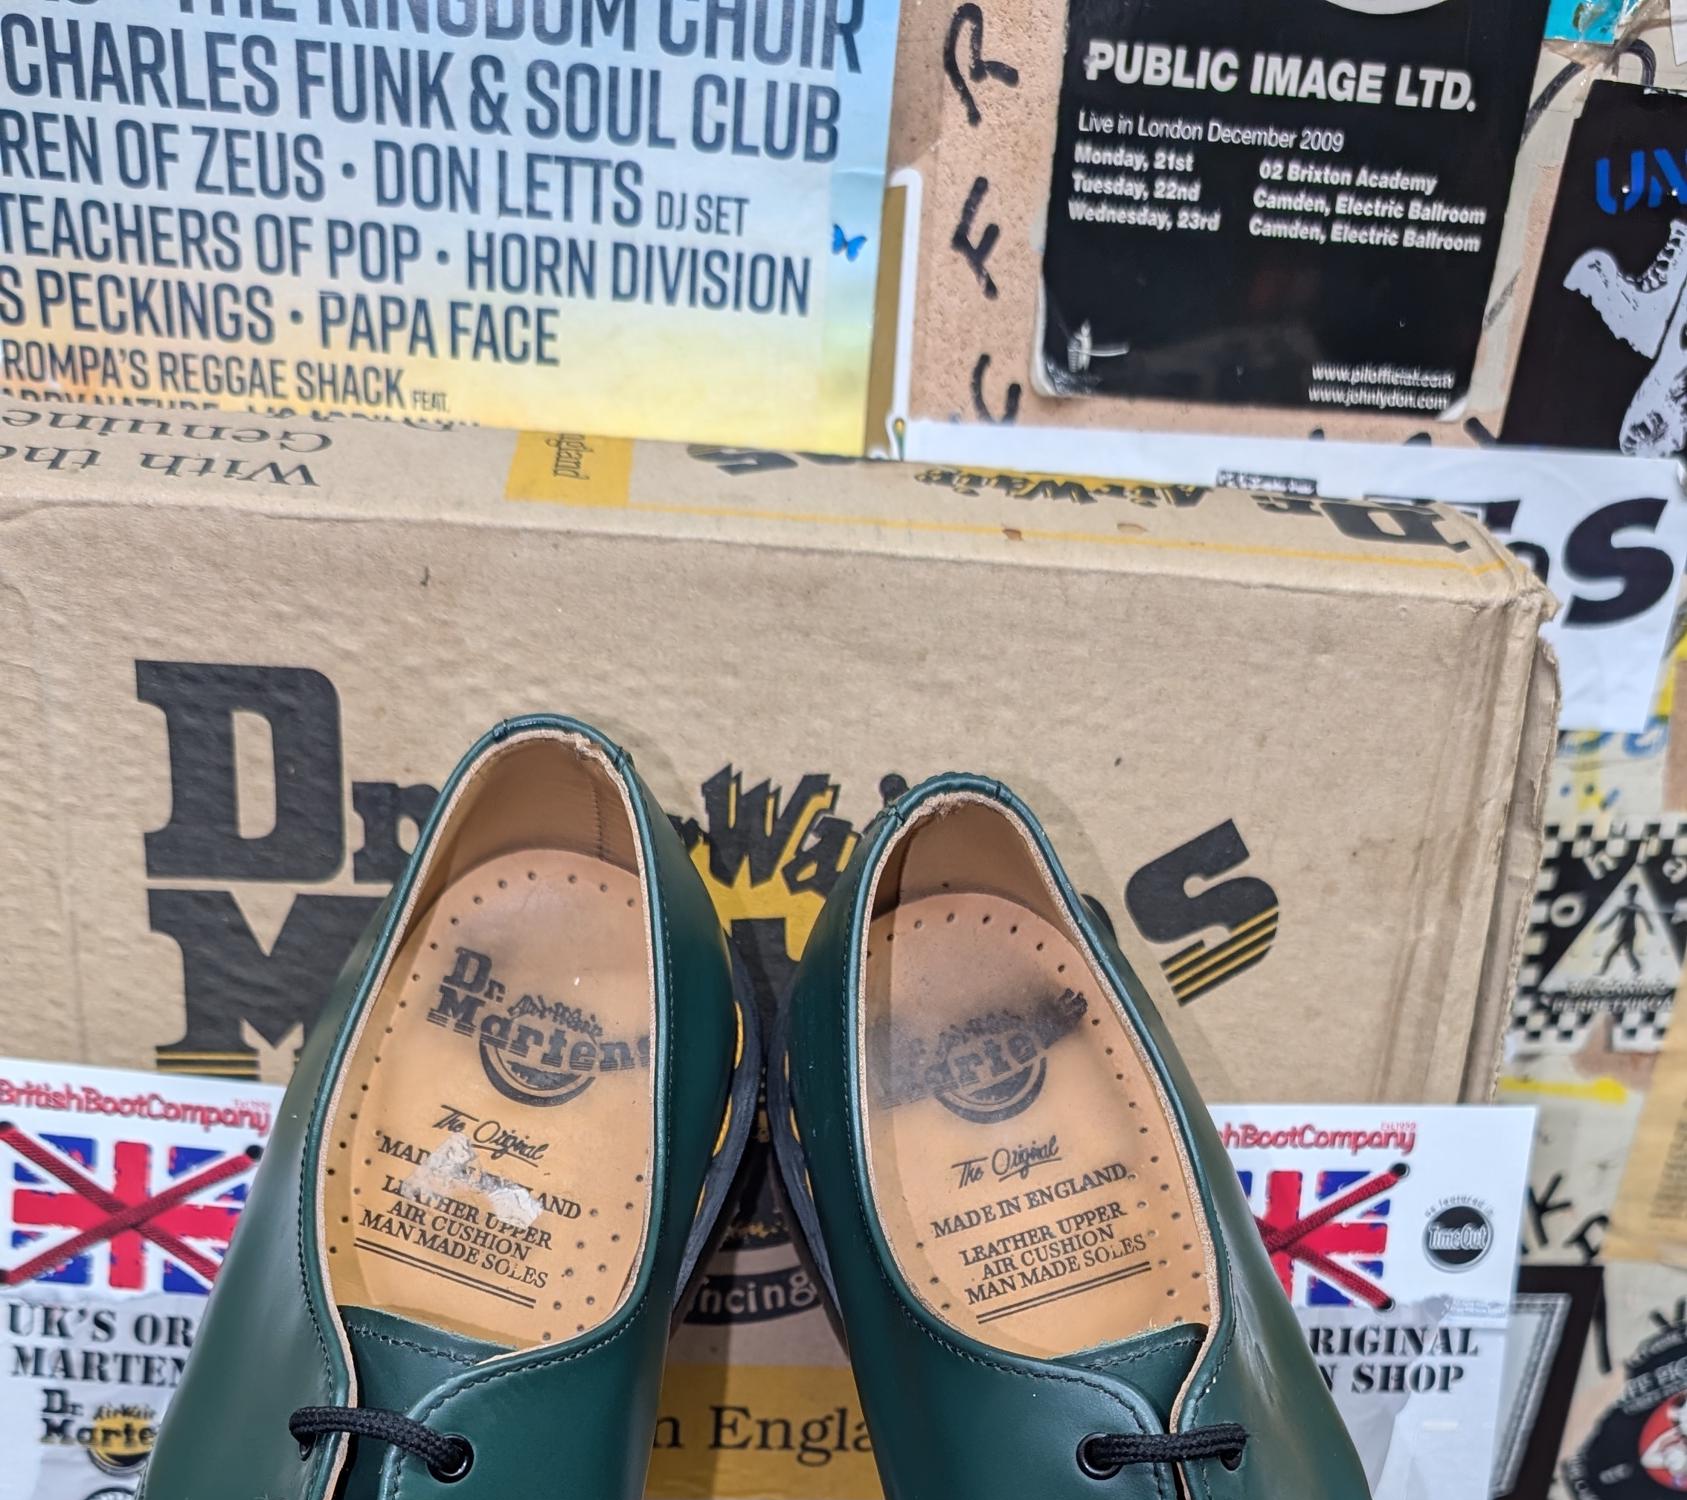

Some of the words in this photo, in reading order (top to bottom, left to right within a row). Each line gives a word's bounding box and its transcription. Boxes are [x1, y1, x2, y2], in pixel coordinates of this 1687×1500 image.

[2, 13, 280, 117] CHARLES
[296, 39, 457, 131] FUNK
[470, 54, 512, 136] &
[526, 60, 676, 149] SOUL
[693, 74, 842, 163] CLUB
[1084, 40, 1240, 92] PUBLIC
[1250, 52, 1386, 104] IMAGE
[1394, 66, 1477, 112] LTD.
[1074, 143, 1149, 171] Monday,
[1153, 150, 1195, 173] 21st
[1078, 109, 1114, 134] Live
[1117, 115, 1134, 136] in
[1137, 115, 1202, 141] London
[1207, 122, 1297, 148] December
[1300, 130, 1344, 153] 2009
[115, 119, 178, 190] OF
[191, 125, 325, 202] ZEUS
[373, 140, 479, 215] DON
[498, 150, 643, 228] LETTS
[657, 190, 687, 232] DJ
[696, 195, 750, 236] SET
[1071, 171, 1149, 201] Tuesday,
[1153, 178, 1201, 202] 22nd
[1287, 161, 1352, 187] Brixton
[1355, 167, 1438, 195] Academy
[1068, 200, 1173, 231] Wednesday,
[1176, 208, 1222, 232] 23rd
[1249, 215, 1327, 244] Camden,
[1331, 222, 1399, 248] Electric
[1402, 229, 1482, 253] Ballroom
[1253, 188, 1331, 217] Camden,
[1335, 195, 1404, 220] Electric
[1407, 202, 1487, 226] Ballroom
[0, 193, 242, 272] TEACHERS
[255, 213, 313, 277] OF
[327, 219, 421, 284] POP
[467, 230, 596, 300] HORN
[612, 242, 811, 317] DIVISION
[36, 269, 275, 345] PECKINGS
[319, 290, 437, 360] PAPA
[449, 301, 560, 367] FACE
[2, 339, 150, 391] ROMPA'S
[159, 352, 286, 400] REGGAE
[296, 361, 407, 410] SHACK
[1, 408, 333, 453] Genuine
[543, 433, 595, 480] ngland
[138, 451, 321, 488] With
[443, 947, 506, 1002] Dr.
[432, 1104, 478, 1133] The
[472, 1120, 549, 1168] Original
[951, 1157, 988, 1188] The
[992, 1135, 1062, 1182] Original
[931, 1210, 996, 1239] MADE
[999, 1196, 1022, 1218] IN
[1027, 1163, 1130, 1211] ENGLAND
[359, 1209, 414, 1242] MAN
[413, 1228, 480, 1264] MADE
[481, 1253, 549, 1290] SOLES
[387, 1200, 427, 1226] AIR
[431, 1215, 533, 1261] CUSHION
[959, 1227, 1055, 1267] LEATHER
[1056, 1201, 1128, 1235] UPPER
[982, 1253, 1017, 1281] AIR
[1019, 1224, 1115, 1267] CUSHION
[964, 1278, 1018, 1306] MAN
[1020, 1256, 1081, 1287] MADE
[1083, 1234, 1148, 1268] SOLES
[8, 1303, 118, 1343] UK'S
[10, 1345, 186, 1389] MARTE
[1351, 1364, 1464, 1394] SHOP
